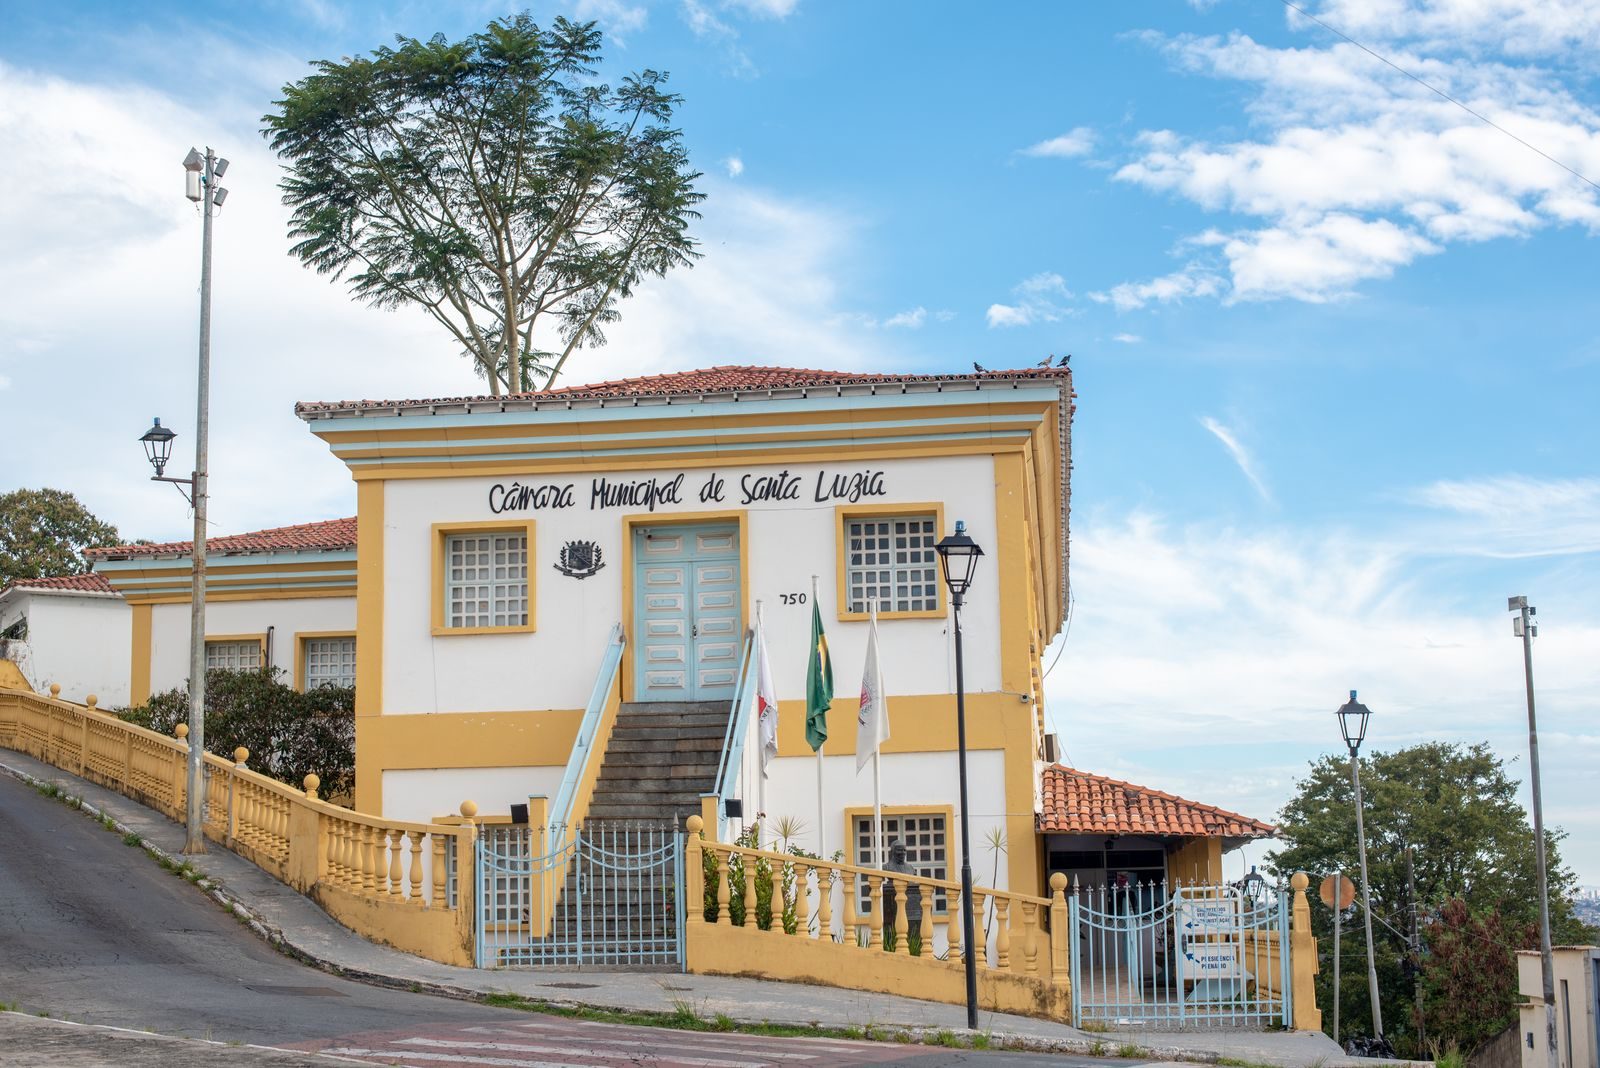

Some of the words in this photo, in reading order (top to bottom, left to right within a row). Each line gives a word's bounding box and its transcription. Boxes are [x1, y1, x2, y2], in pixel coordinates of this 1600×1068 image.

[488, 482, 576, 514] Câmara
[590, 472, 685, 512] Municipal
[699, 472, 725, 504] de
[741, 470, 801, 505] Santa
[814, 469, 887, 505] Luzia
[779, 592, 807, 605] 750
